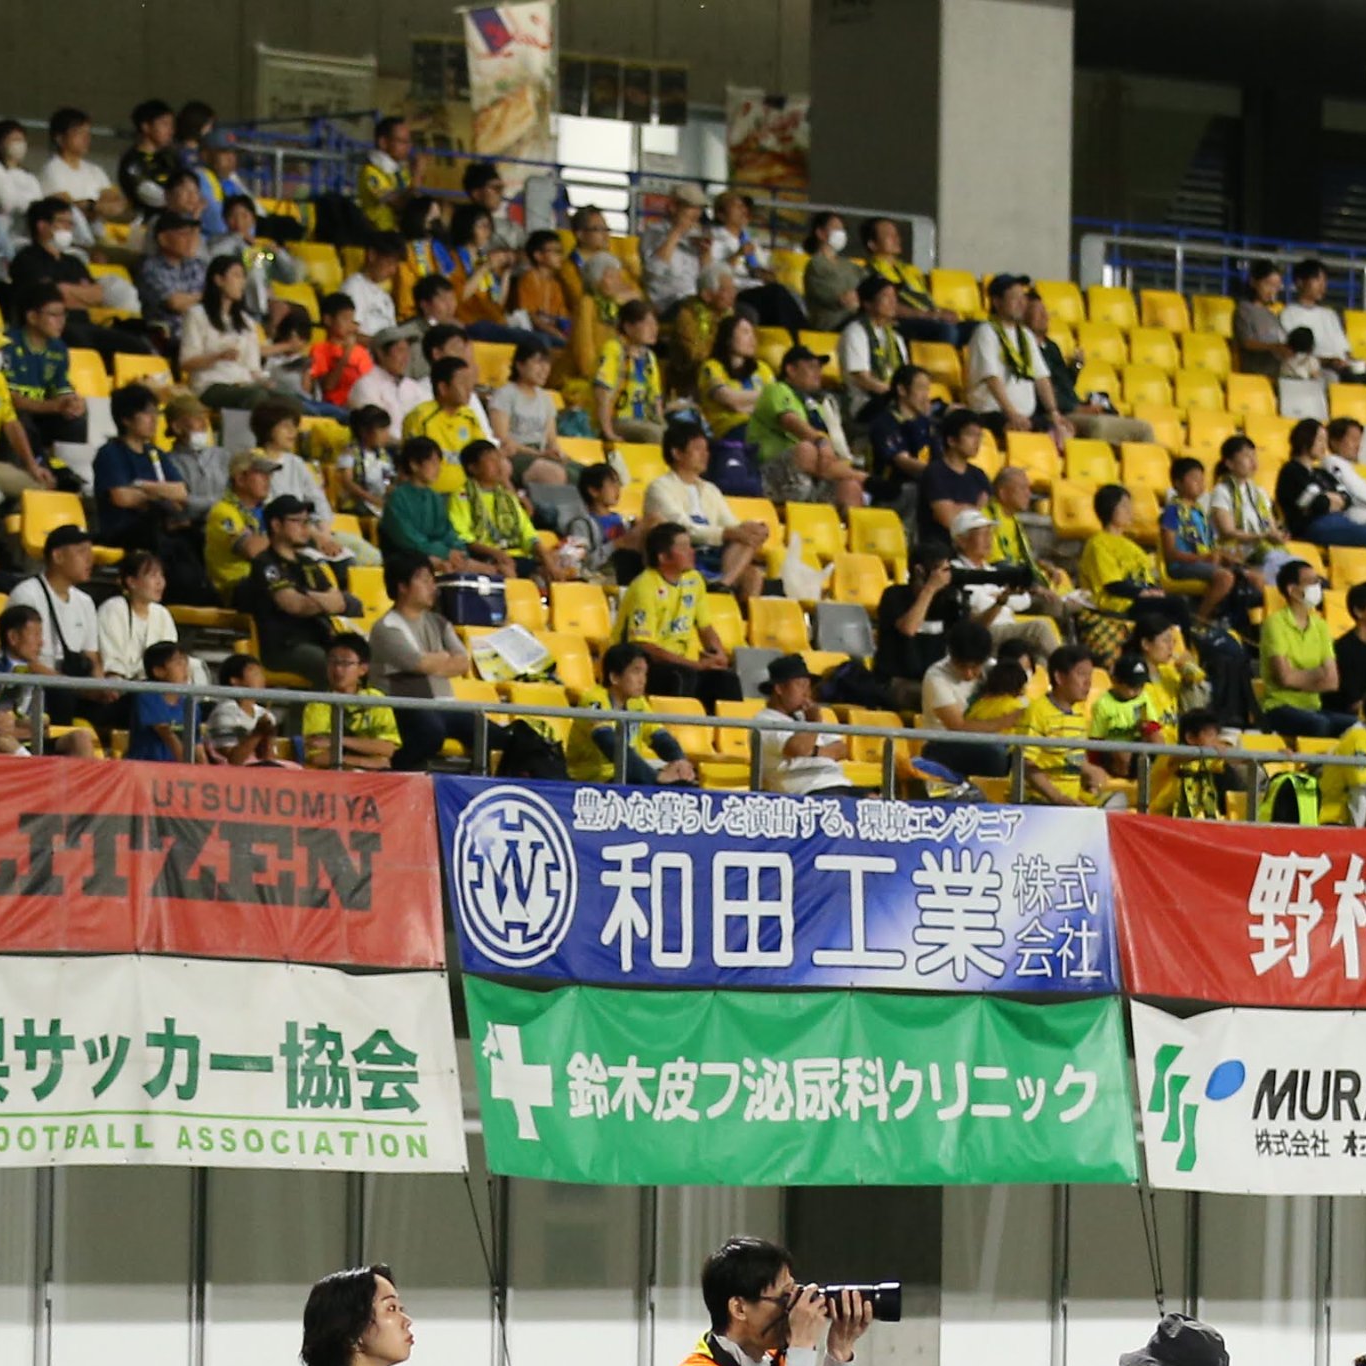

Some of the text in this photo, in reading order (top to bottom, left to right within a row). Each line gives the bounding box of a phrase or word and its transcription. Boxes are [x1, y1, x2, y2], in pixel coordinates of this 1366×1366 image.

[152, 779, 381, 825] UTSUNOMIYA
[600, 841, 1006, 982] 和田工業
[1011, 852, 1099, 917] 株式
[1014, 917, 1104, 980] 会社
[565, 1050, 1098, 1124] 鈴木皮フ泌尿科クリニック
[176, 1125, 429, 1159] ASSOCIATION
[1253, 1129, 1331, 1159] 株式会社
